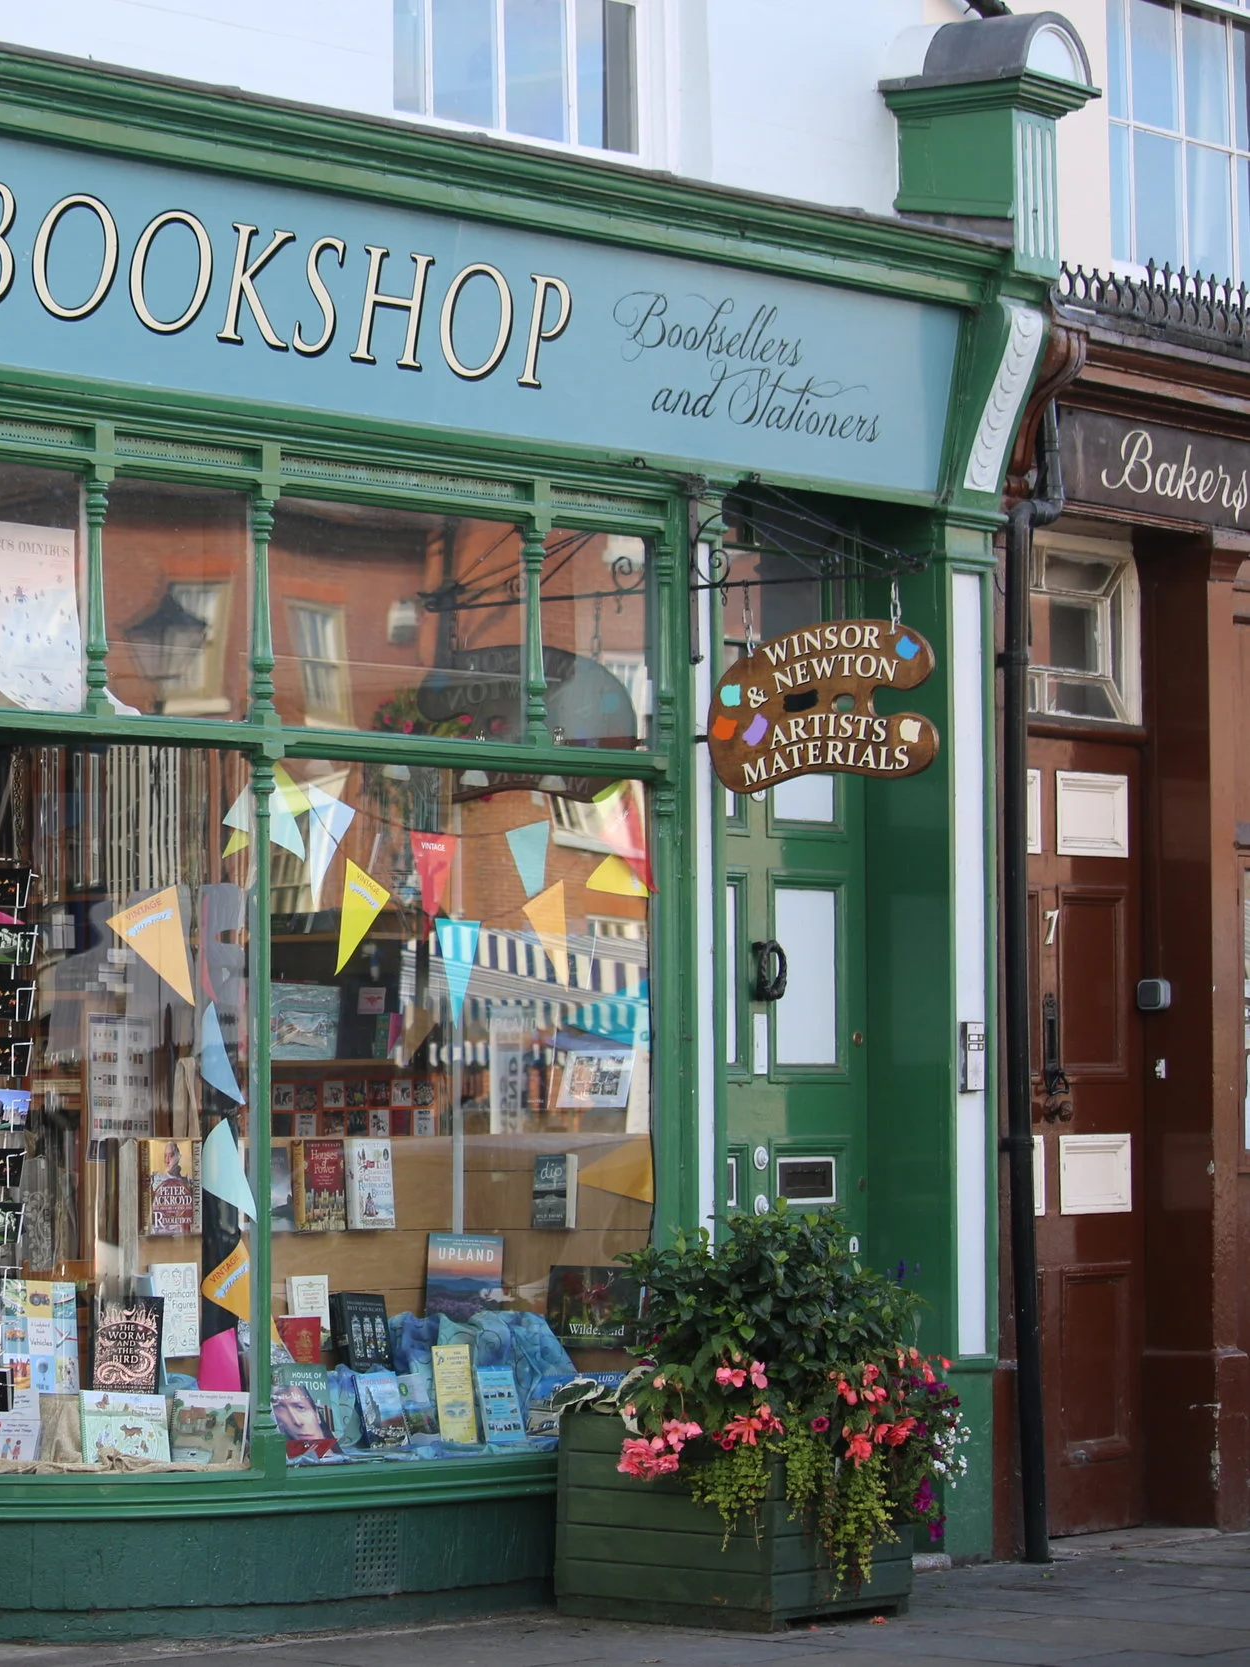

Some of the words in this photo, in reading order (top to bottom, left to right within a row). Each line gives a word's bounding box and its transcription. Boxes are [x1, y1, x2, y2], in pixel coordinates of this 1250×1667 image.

[613, 291, 803, 368] Booksellers
[651, 360, 727, 418] and
[727, 367, 882, 443] Stationers
[18, 540, 71, 557] OMNIBUS
[762, 624, 882, 668] WINSOR
[746, 686, 770, 709] &
[772, 653, 900, 694] NEWTON
[769, 712, 889, 750] ARTISTS
[741, 740, 911, 788] MATERIALS
[421, 841, 446, 852] VINTAGE
[357, 871, 380, 896] VINTAGE
[125, 897, 163, 921] VINTAGE
[1043, 909, 1059, 946] 7
[310, 1149, 338, 1160] Houses
[314, 1163, 336, 1175] Power
[540, 1161, 563, 1188] dip
[160, 1186, 186, 1196] PETER
[153, 1195, 192, 1205] ACKROYD
[438, 1247, 494, 1263] UPLAND
[210, 1253, 240, 1283] VINTAGE
[161, 1289, 196, 1301] Significant
[172, 1300, 197, 1312] Figures
[30, 1339, 52, 1347] Vehicles
[108, 1331, 146, 1340] WORM
[112, 1354, 139, 1364] BIRD
[290, 1380, 327, 1391] FICTION
